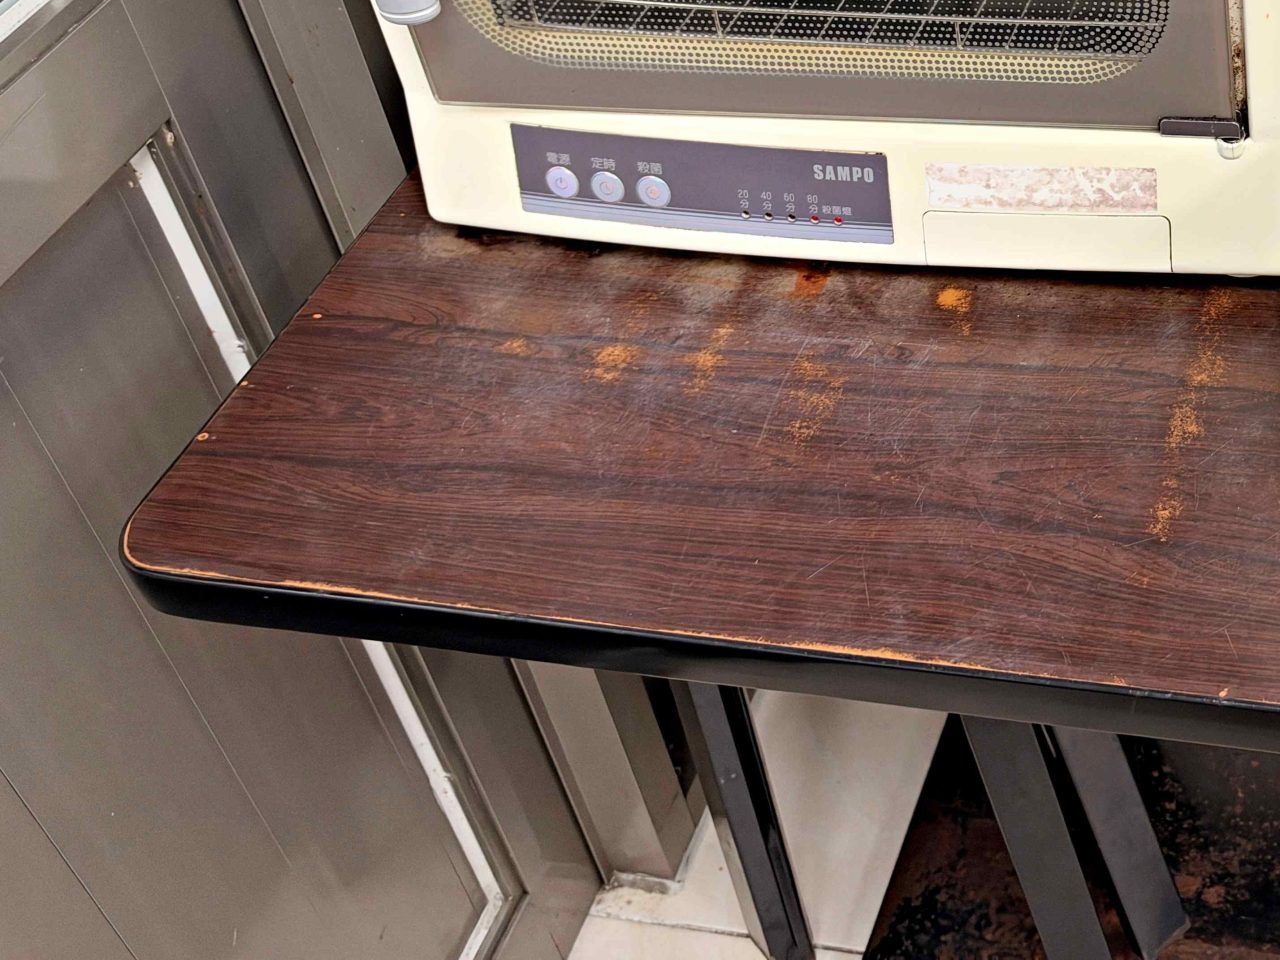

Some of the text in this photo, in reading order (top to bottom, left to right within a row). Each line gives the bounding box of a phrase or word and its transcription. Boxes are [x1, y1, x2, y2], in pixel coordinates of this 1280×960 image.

[546, 151, 571, 166] 電源
[591, 157, 616, 171] 定時
[637, 161, 662, 175] 殺菌
[813, 164, 875, 183] SAMPO
[737, 189, 749, 199] 20
[760, 191, 772, 201] 40
